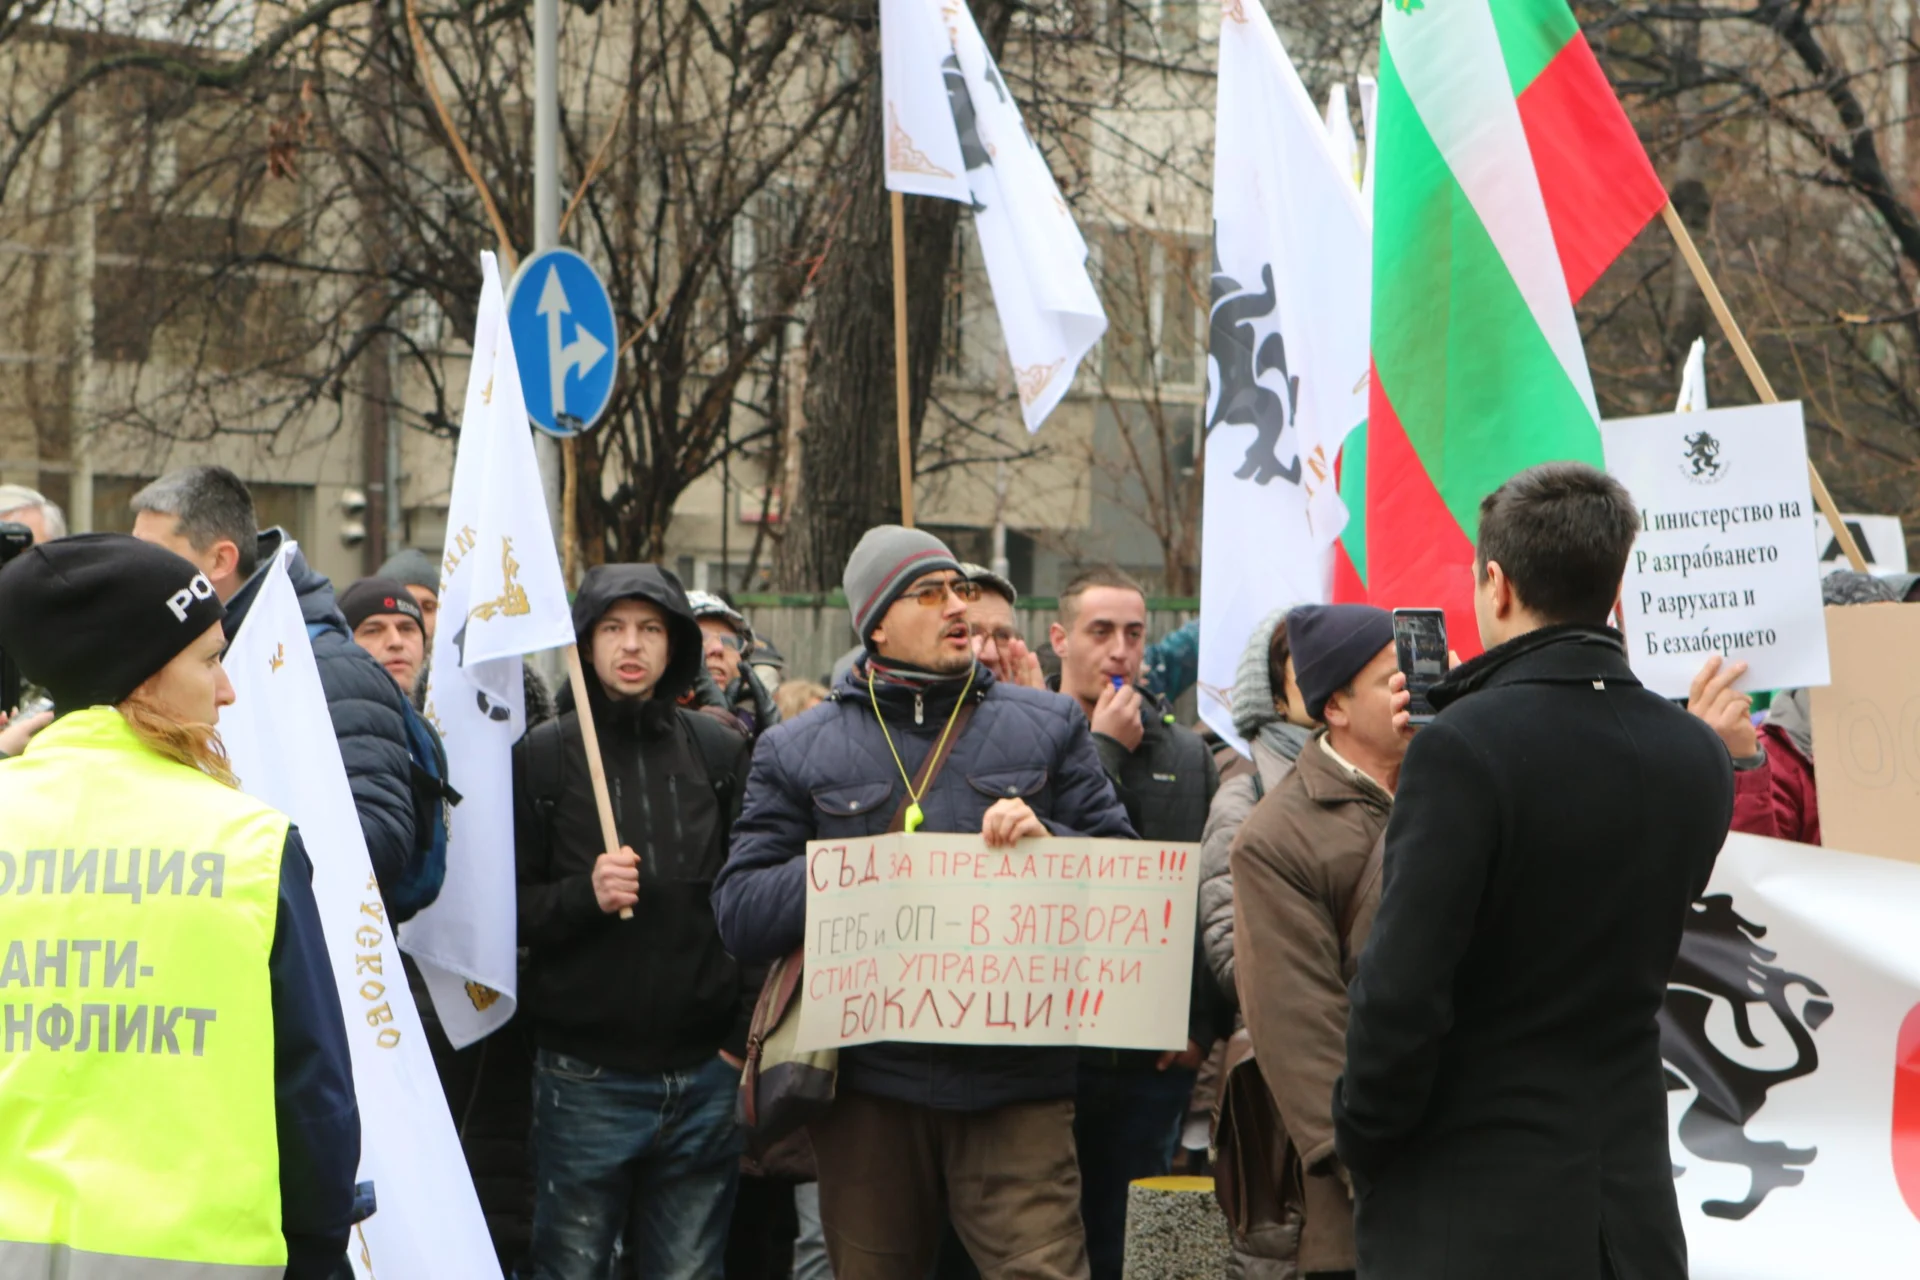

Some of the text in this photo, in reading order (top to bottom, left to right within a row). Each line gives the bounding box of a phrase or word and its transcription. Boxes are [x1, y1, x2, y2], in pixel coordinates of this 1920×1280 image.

[1779, 500, 1801, 520] на
[165, 570, 215, 623] PO
[1743, 588, 1756, 606] и
[810, 844, 1188, 892] СЪД ЗА ПРЕДАТЕЛИТЕ!!!
[816, 913, 870, 955] ГЕРБ
[874, 926, 886, 945] и
[970, 904, 990, 946] В
[1003, 898, 1173, 946] ЗАТВОРА!
[0, 939, 154, 988] АНТИ-
[809, 952, 1142, 1000] СТИГА УПРАВЛЕНСКИ
[0, 1002, 217, 1057] НФЛИКТ
[840, 987, 1105, 1039] БОКЛУЦИ!!!
